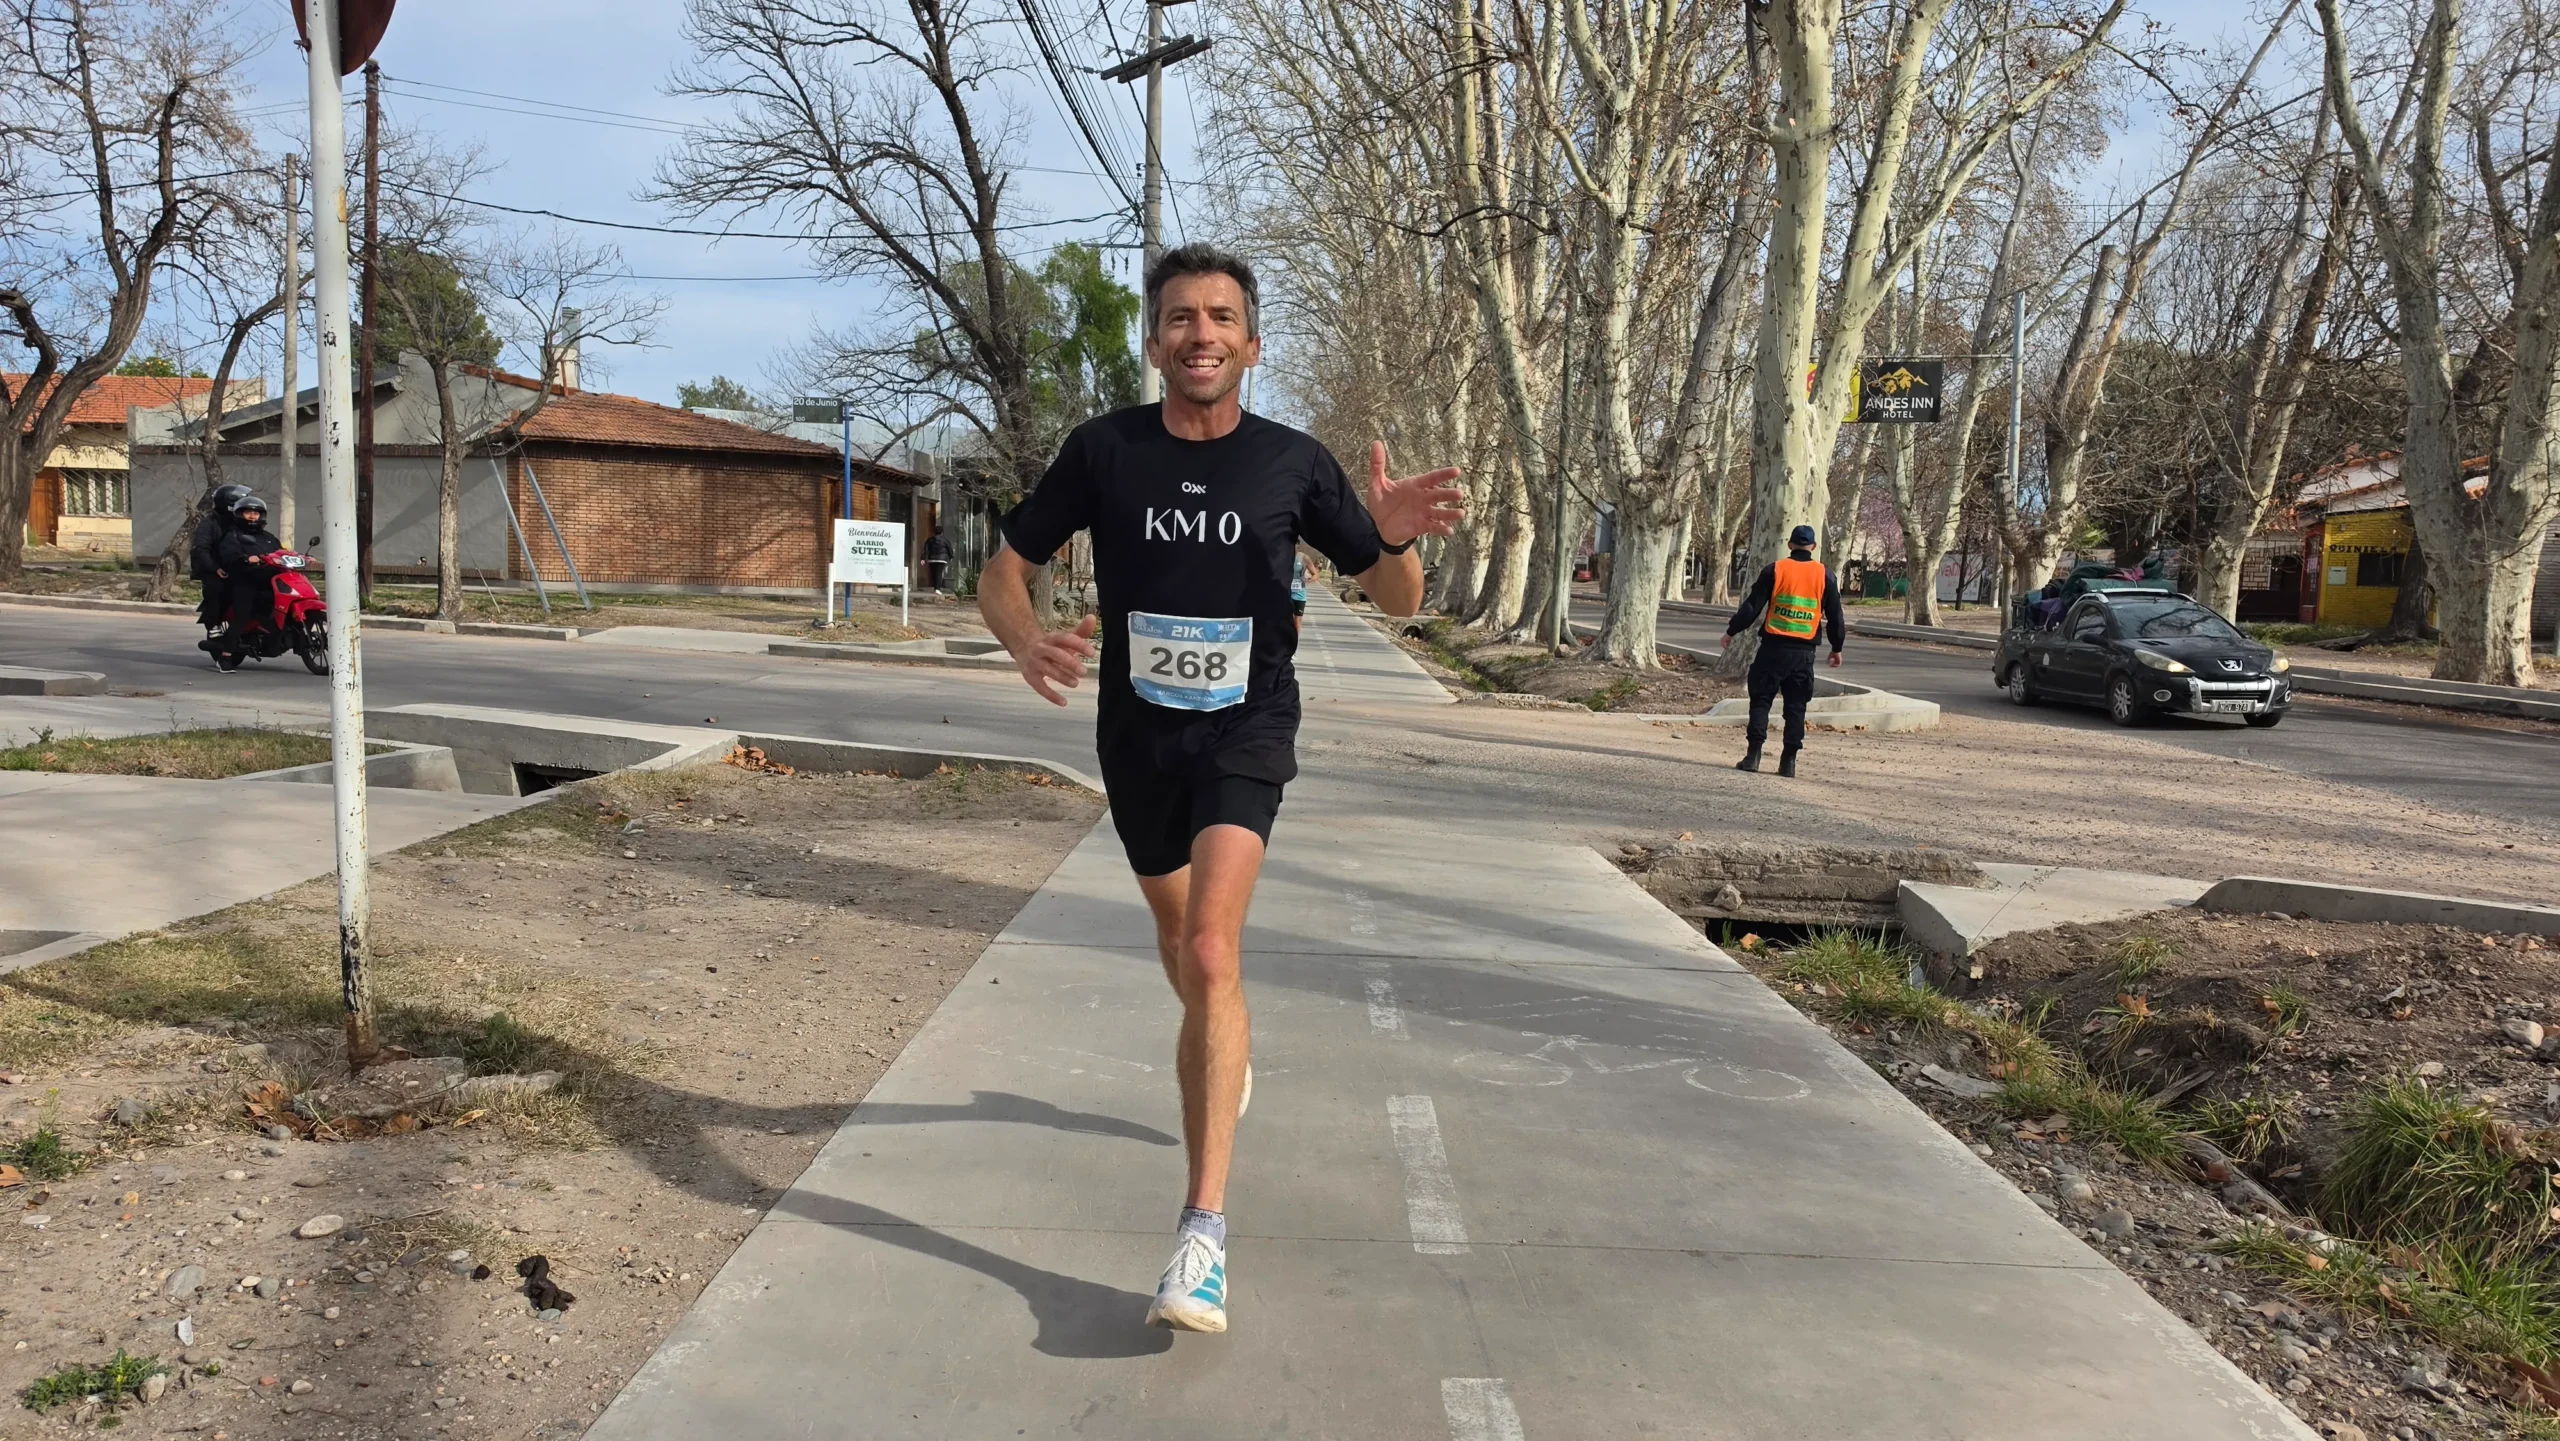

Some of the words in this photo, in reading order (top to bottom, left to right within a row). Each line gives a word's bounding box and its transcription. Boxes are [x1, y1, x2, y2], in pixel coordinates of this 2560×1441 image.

[793, 397, 805, 406] 20
[805, 397, 815, 406] de
[816, 398, 838, 407] Junio
[1865, 397, 1908, 409] ANDES
[1911, 397, 1933, 409] INN
[1882, 410, 1914, 419] HOTEL
[1145, 507, 1207, 543] KM
[1218, 511, 1242, 545] 0
[848, 527, 892, 538] Bienvenidos
[851, 546, 888, 556] SUTER
[2329, 544, 2397, 553] QUINIELA
[1774, 605, 1814, 621] POLICIA
[1171, 625, 1204, 639] 21K
[1150, 646, 1227, 681] 268
